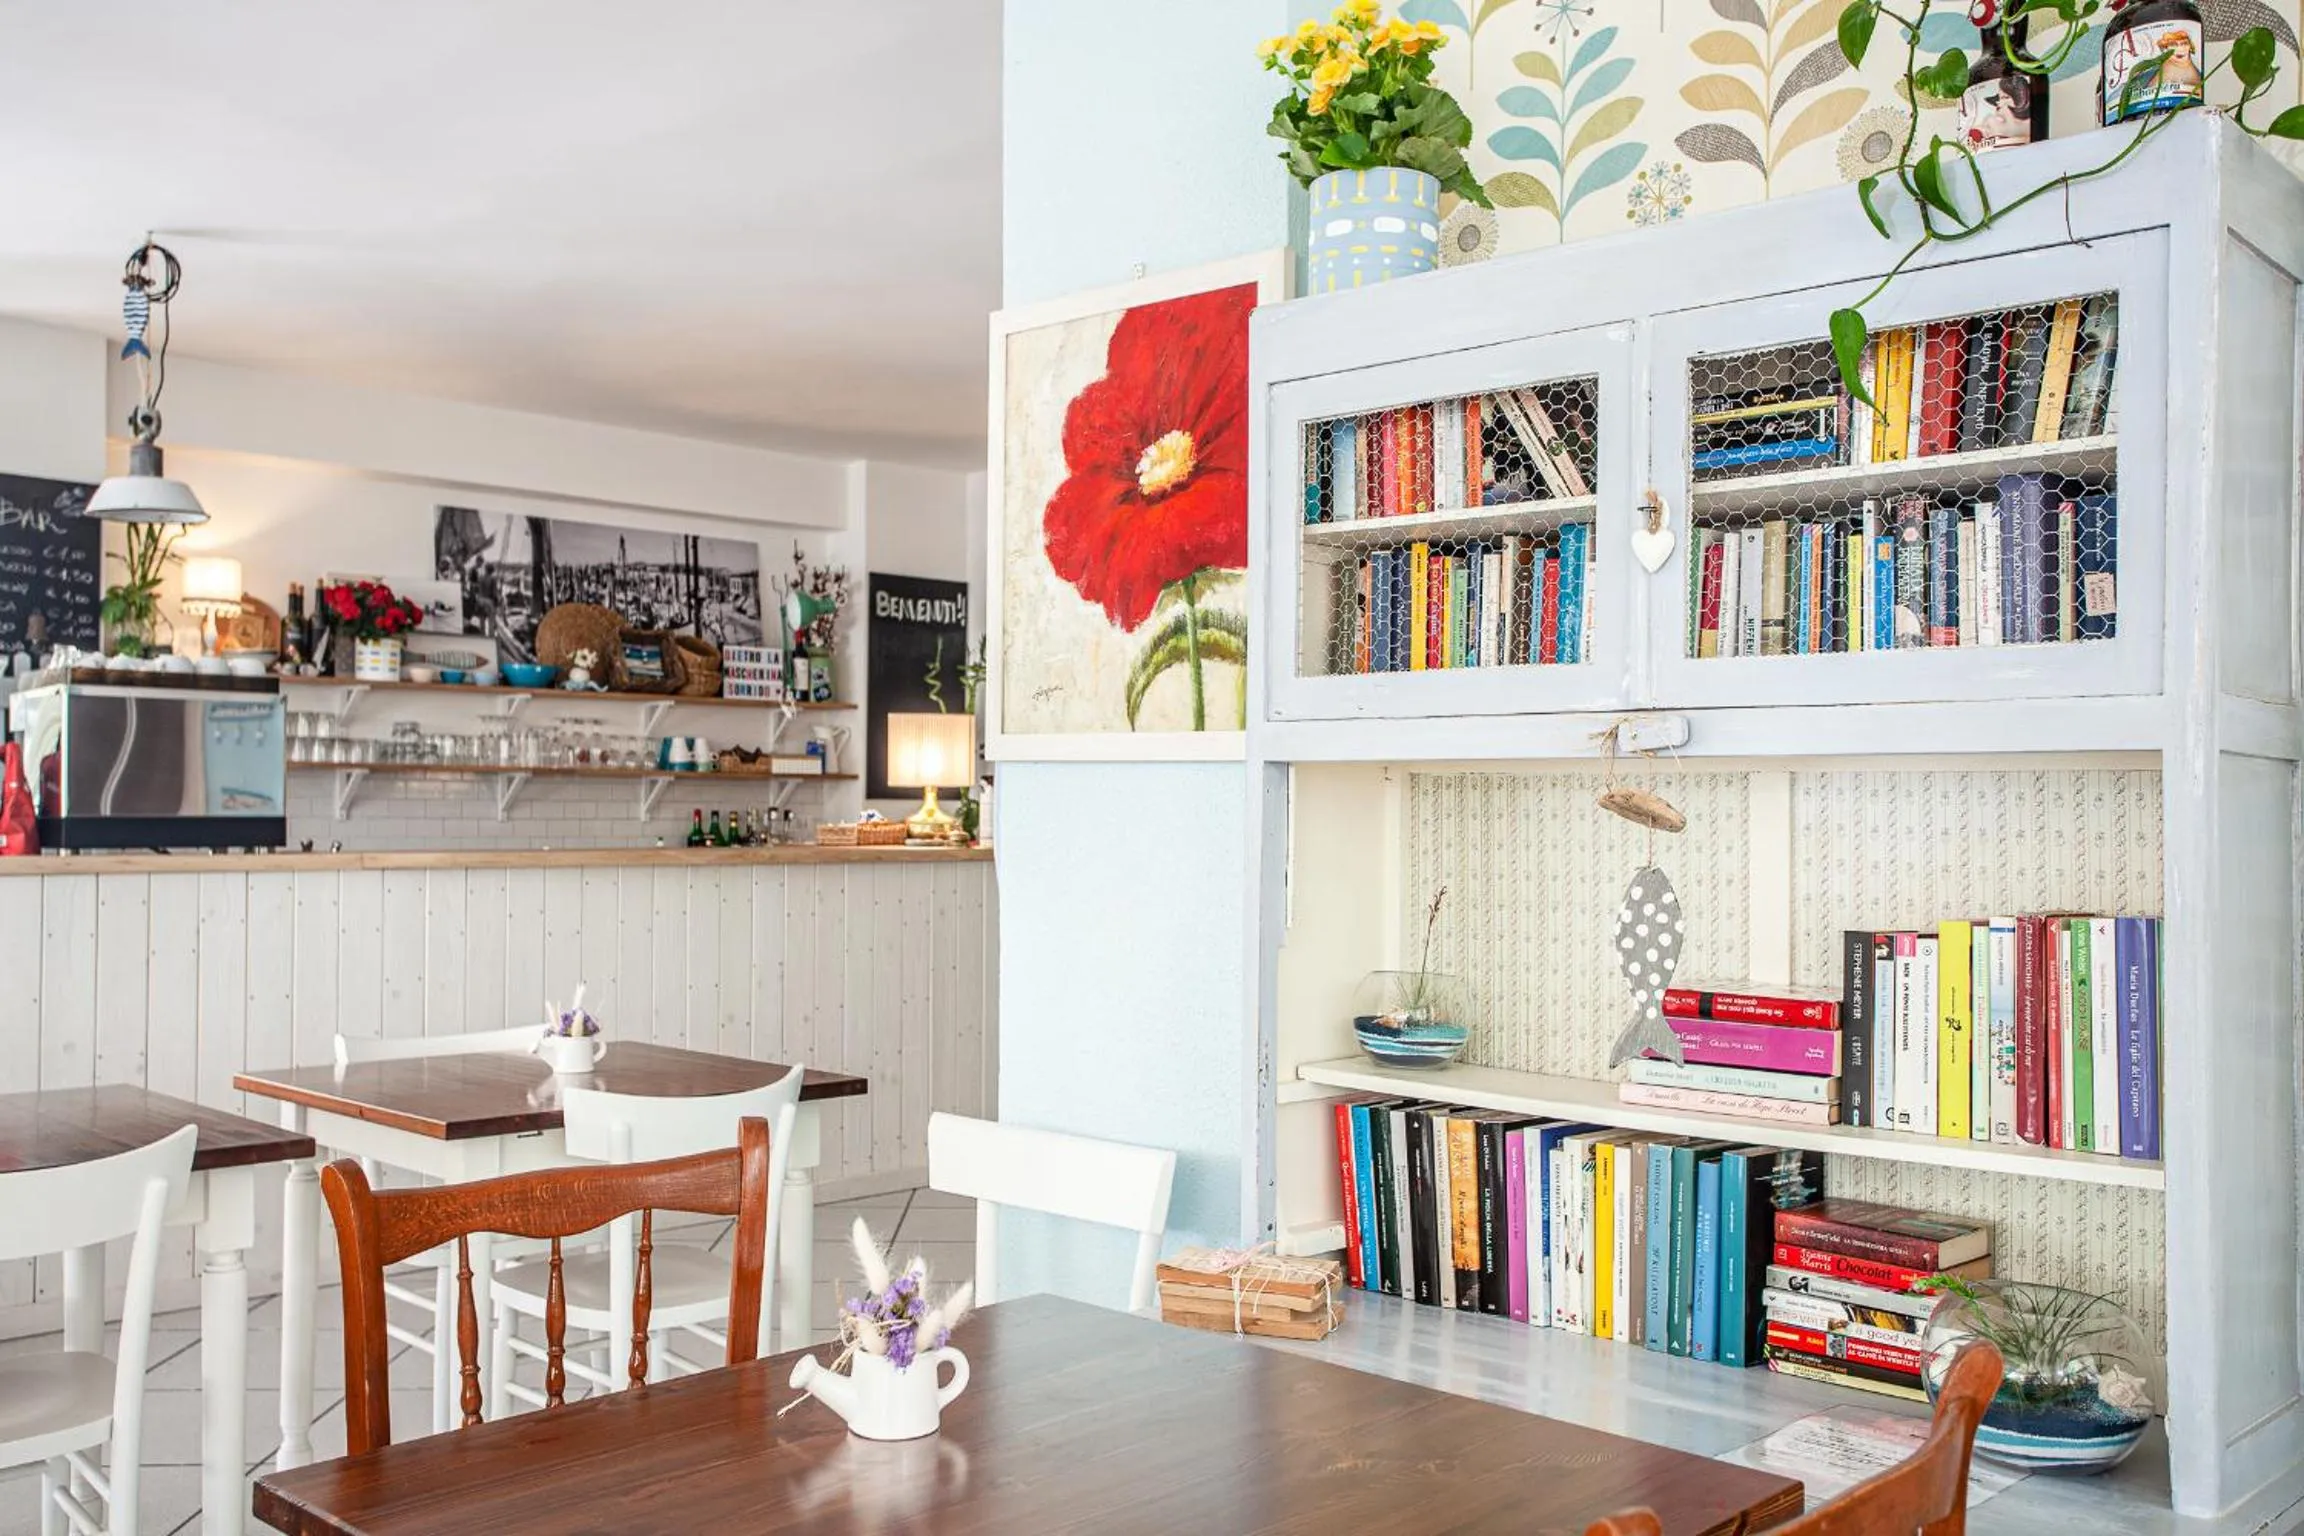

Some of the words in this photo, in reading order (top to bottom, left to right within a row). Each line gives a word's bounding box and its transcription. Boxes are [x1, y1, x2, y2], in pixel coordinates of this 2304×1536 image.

[767, 651, 779, 665] LA
[1853, 942, 1863, 986] STEPHENIE
[1852, 989, 1862, 1020] MEYER
[2131, 1065, 2141, 1077] del
[2129, 1080, 2142, 1117] Capitano
[1484, 1188, 1491, 1197] LA
[1801, 1257, 1831, 1271] Harris
[1836, 1258, 1893, 1280] Chocolat
[1867, 1330, 1899, 1342] good
[1847, 1342, 1882, 1354] POMODORI
